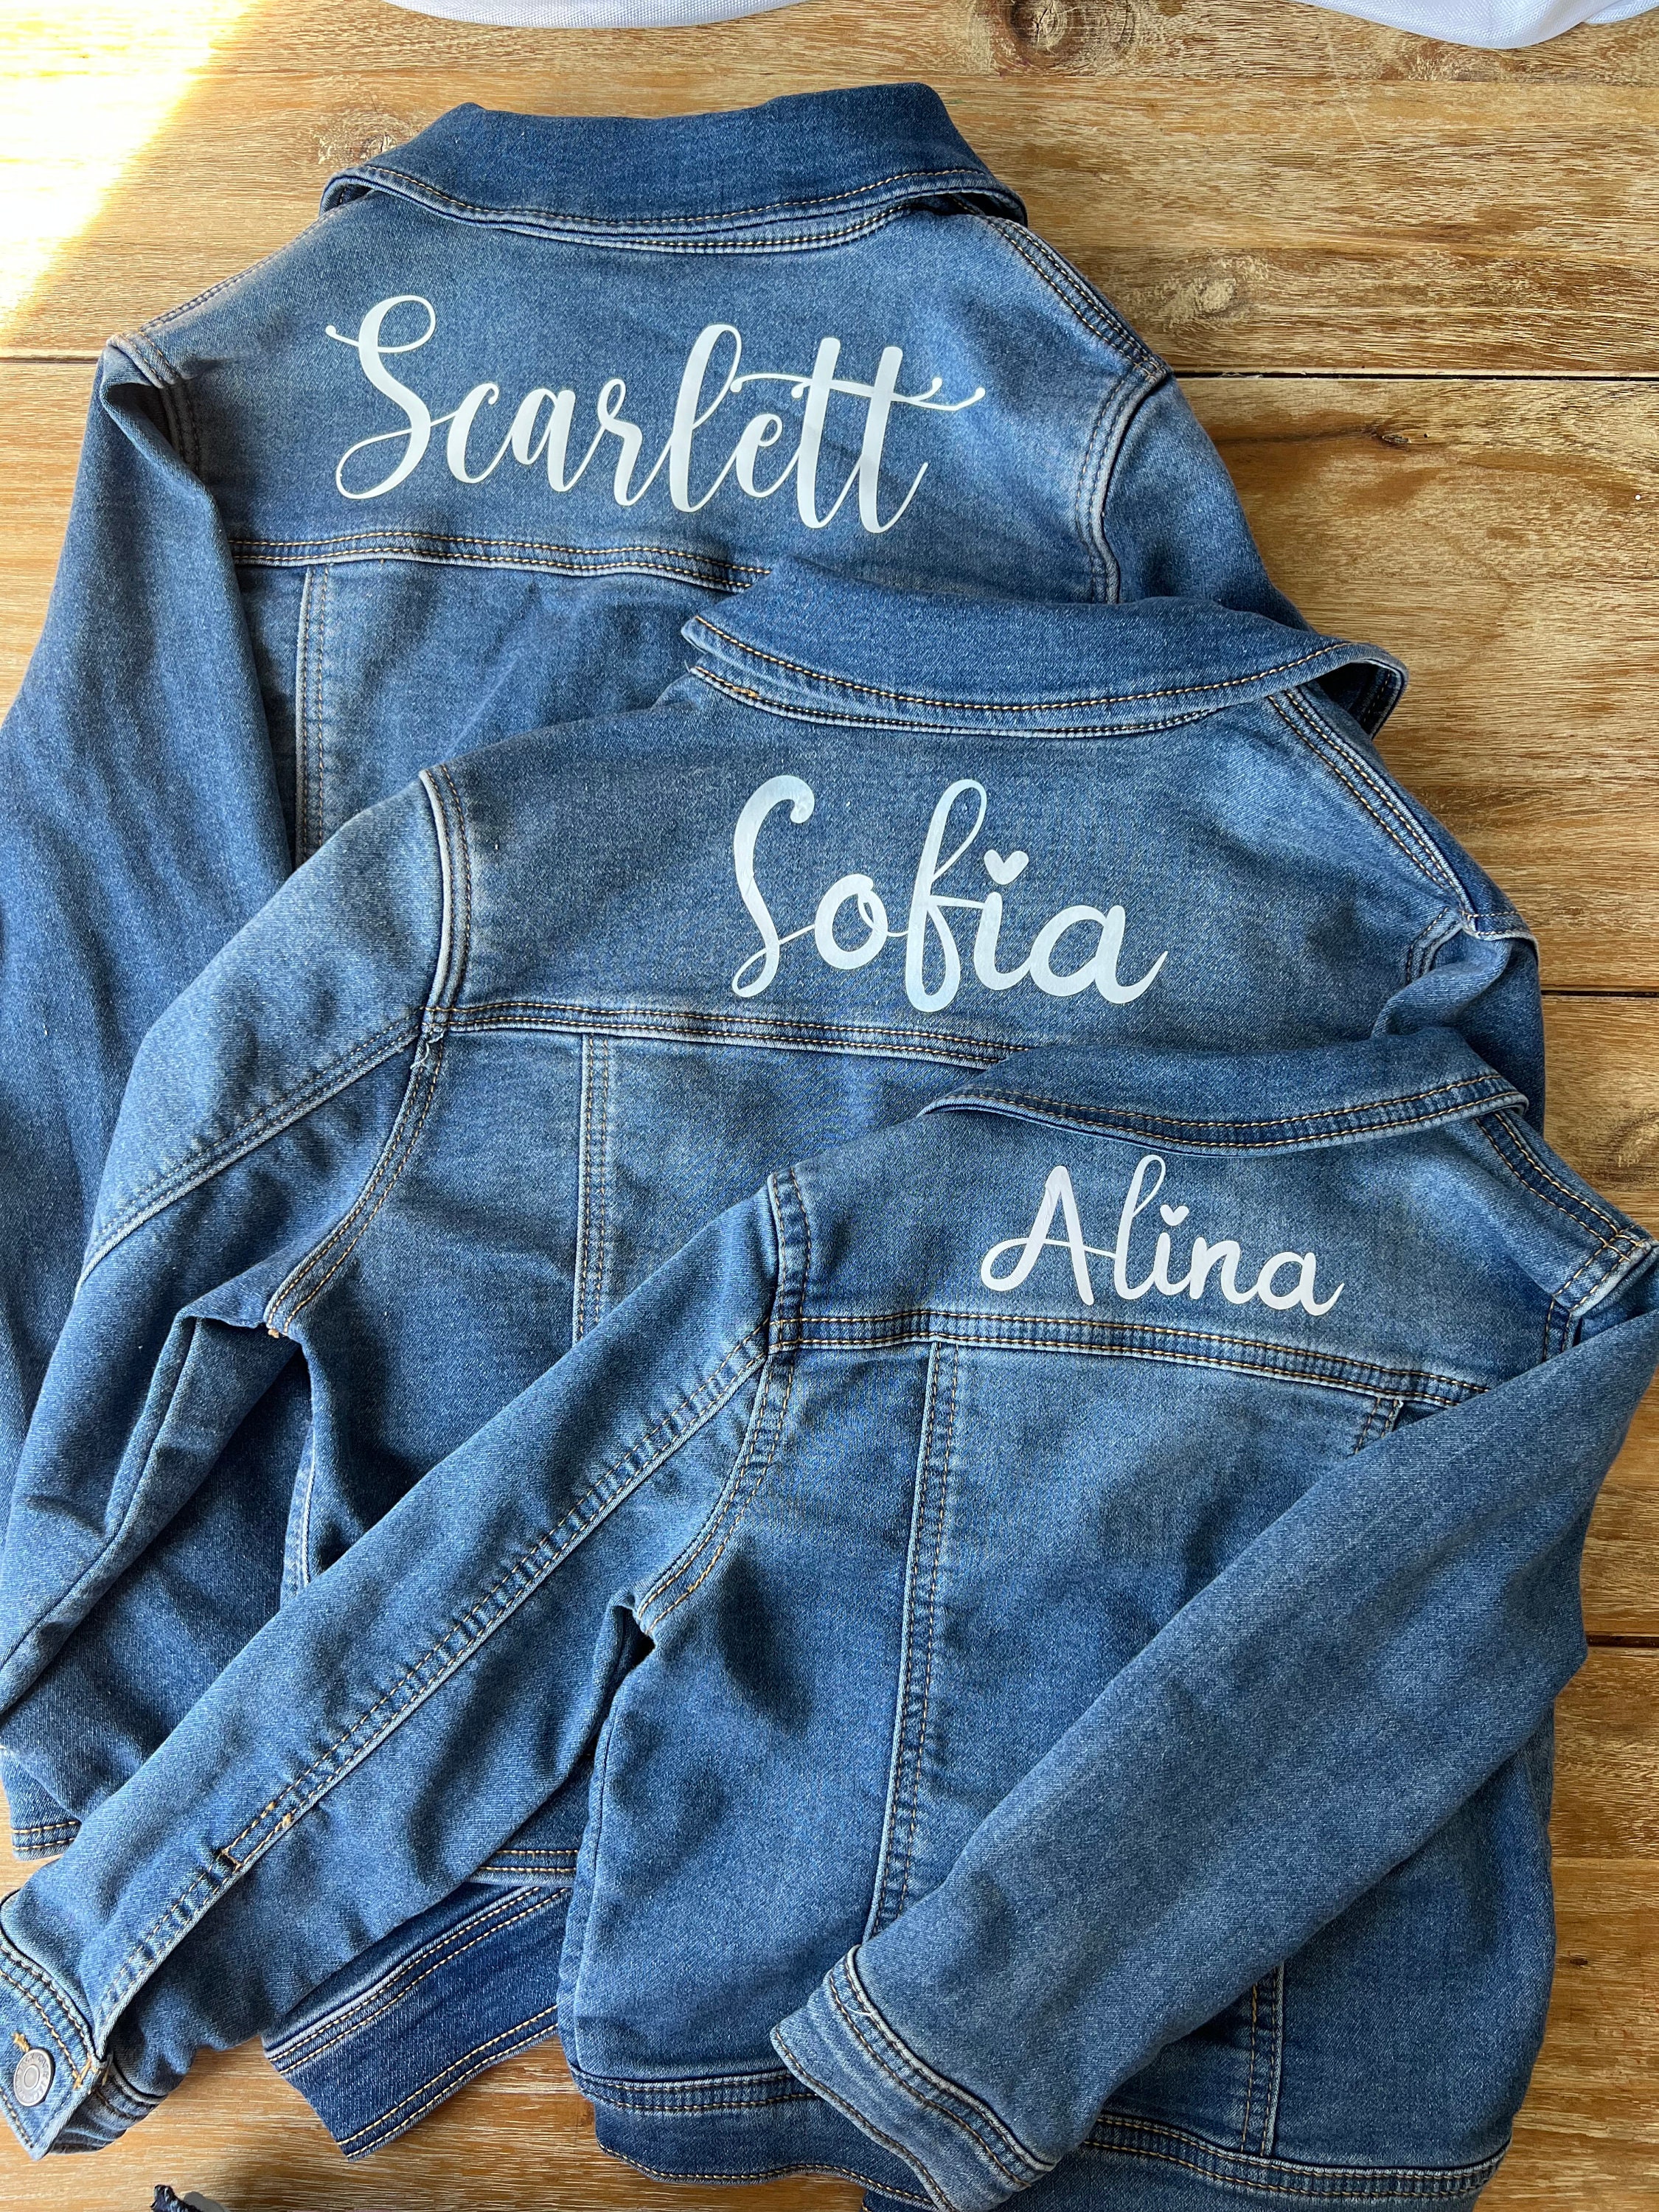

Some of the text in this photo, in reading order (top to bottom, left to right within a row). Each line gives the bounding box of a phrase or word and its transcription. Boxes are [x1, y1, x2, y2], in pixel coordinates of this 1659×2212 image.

[325, 295, 986, 533] Scarlett
[732, 775, 1169, 1013] Sofia
[981, 1154, 1345, 1316] Alina
